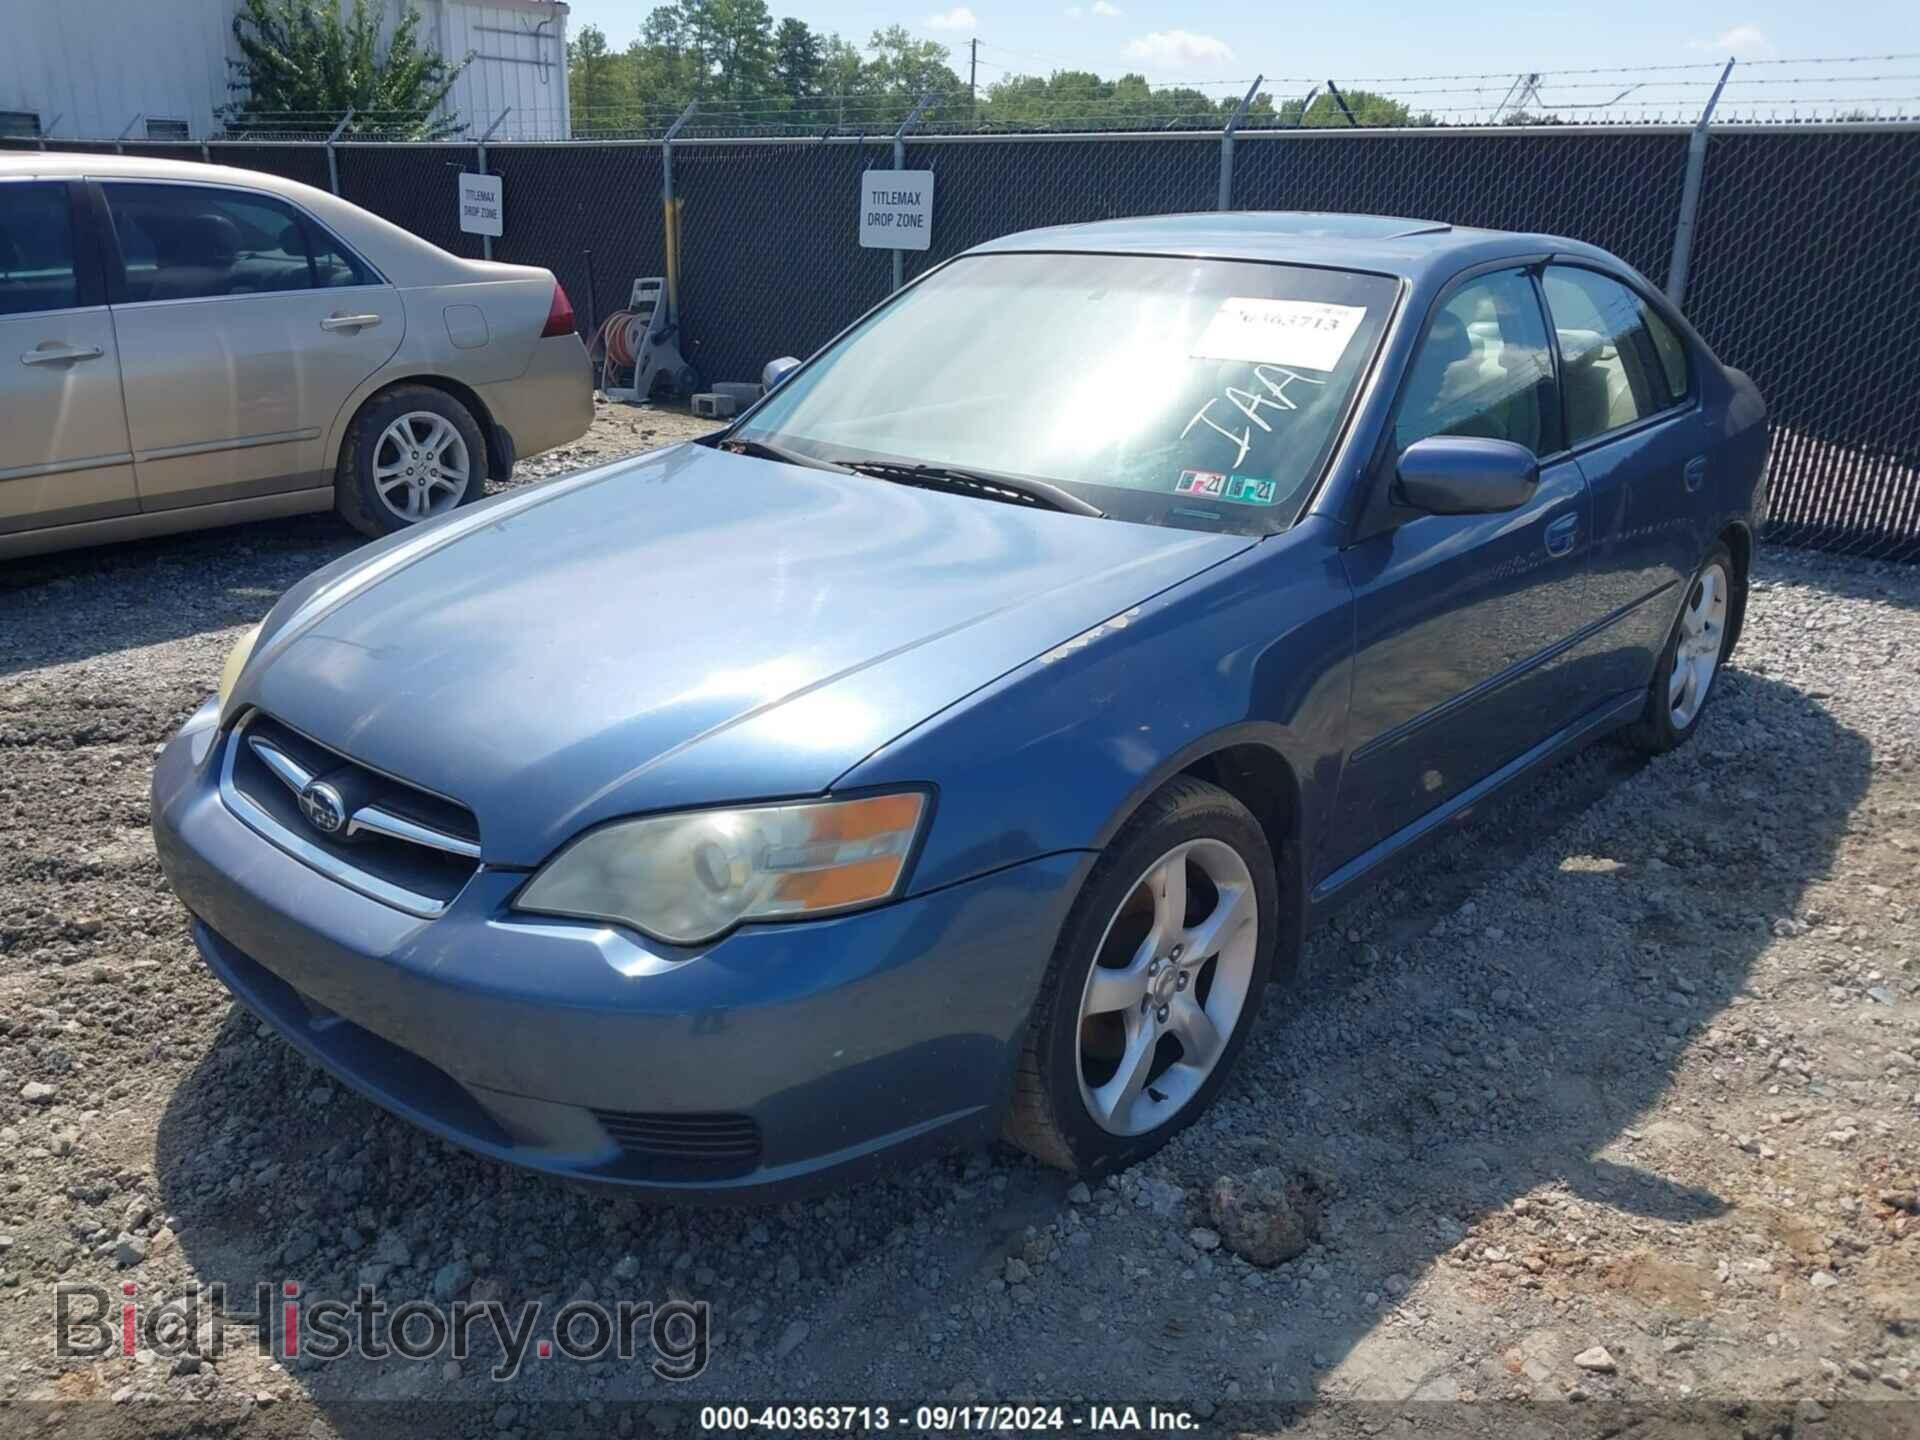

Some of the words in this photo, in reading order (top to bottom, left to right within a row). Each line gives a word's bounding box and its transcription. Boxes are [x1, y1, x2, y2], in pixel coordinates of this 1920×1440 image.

[871, 191, 921, 206] TITLEMAX
[867, 212, 894, 226] DROP
[896, 213, 924, 228] ZONE
[1180, 364, 1327, 468] IAA
